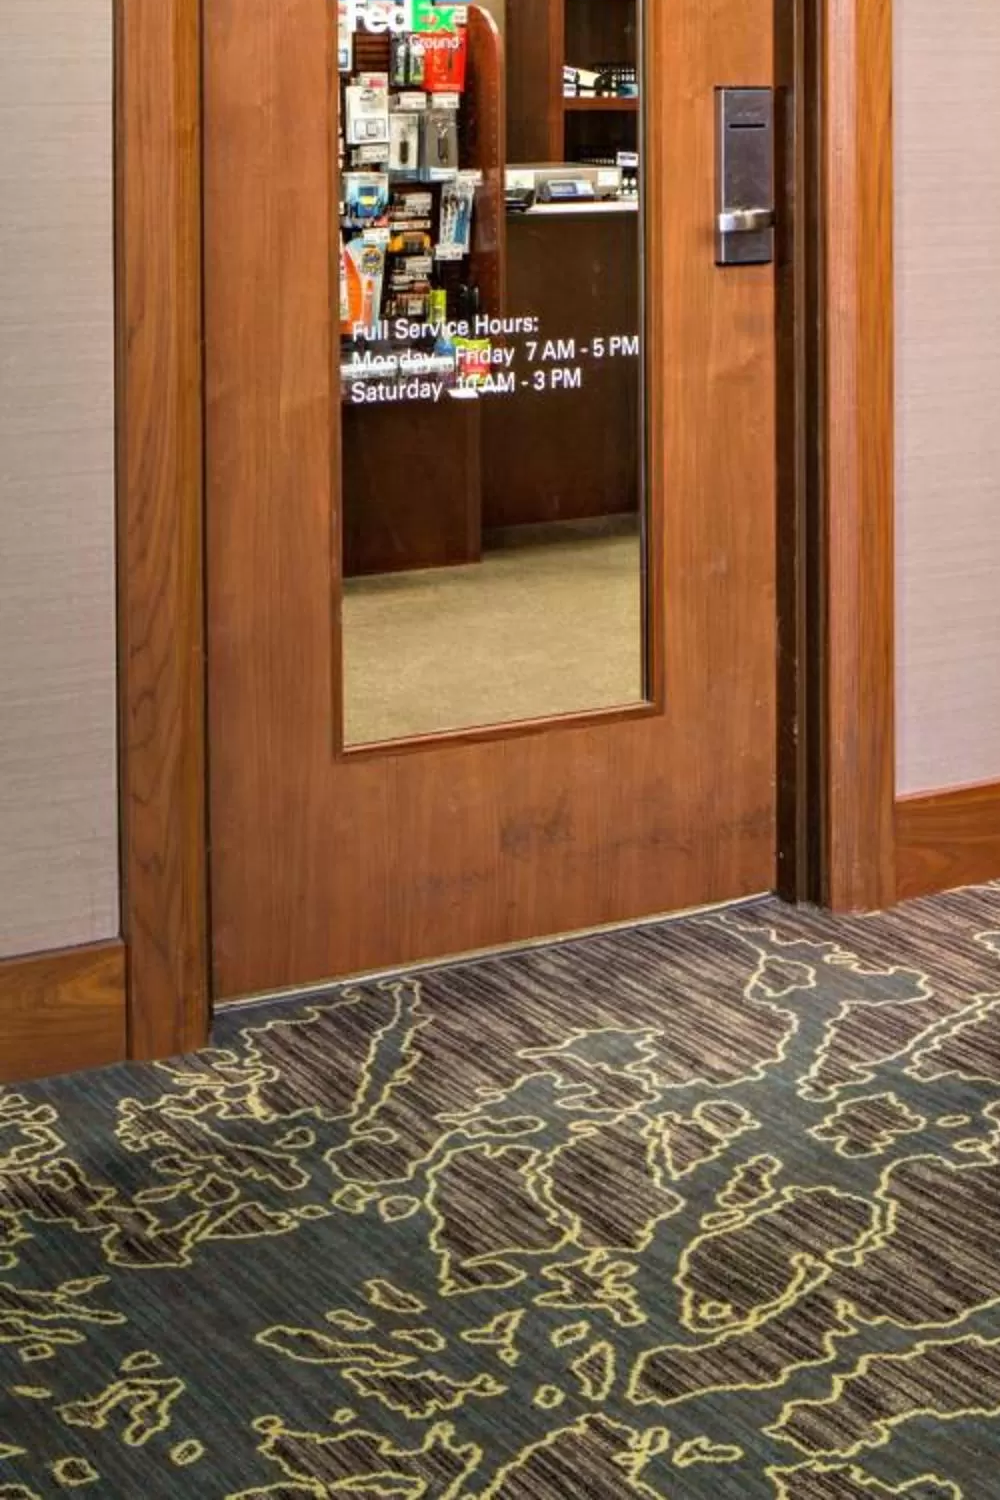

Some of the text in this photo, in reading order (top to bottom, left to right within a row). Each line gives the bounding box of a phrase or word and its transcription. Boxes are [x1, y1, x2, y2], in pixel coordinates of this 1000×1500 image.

[353, 313, 539, 342] Full Service Hours:
[455, 343, 515, 368] Friday
[526, 341, 537, 361] 7
[542, 338, 575, 361] AM
[593, 338, 604, 358] 5
[609, 335, 640, 357] PM
[351, 378, 444, 403] Saturday
[481, 371, 516, 393] AM
[533, 370, 545, 391] 3
[551, 367, 582, 389] PM
